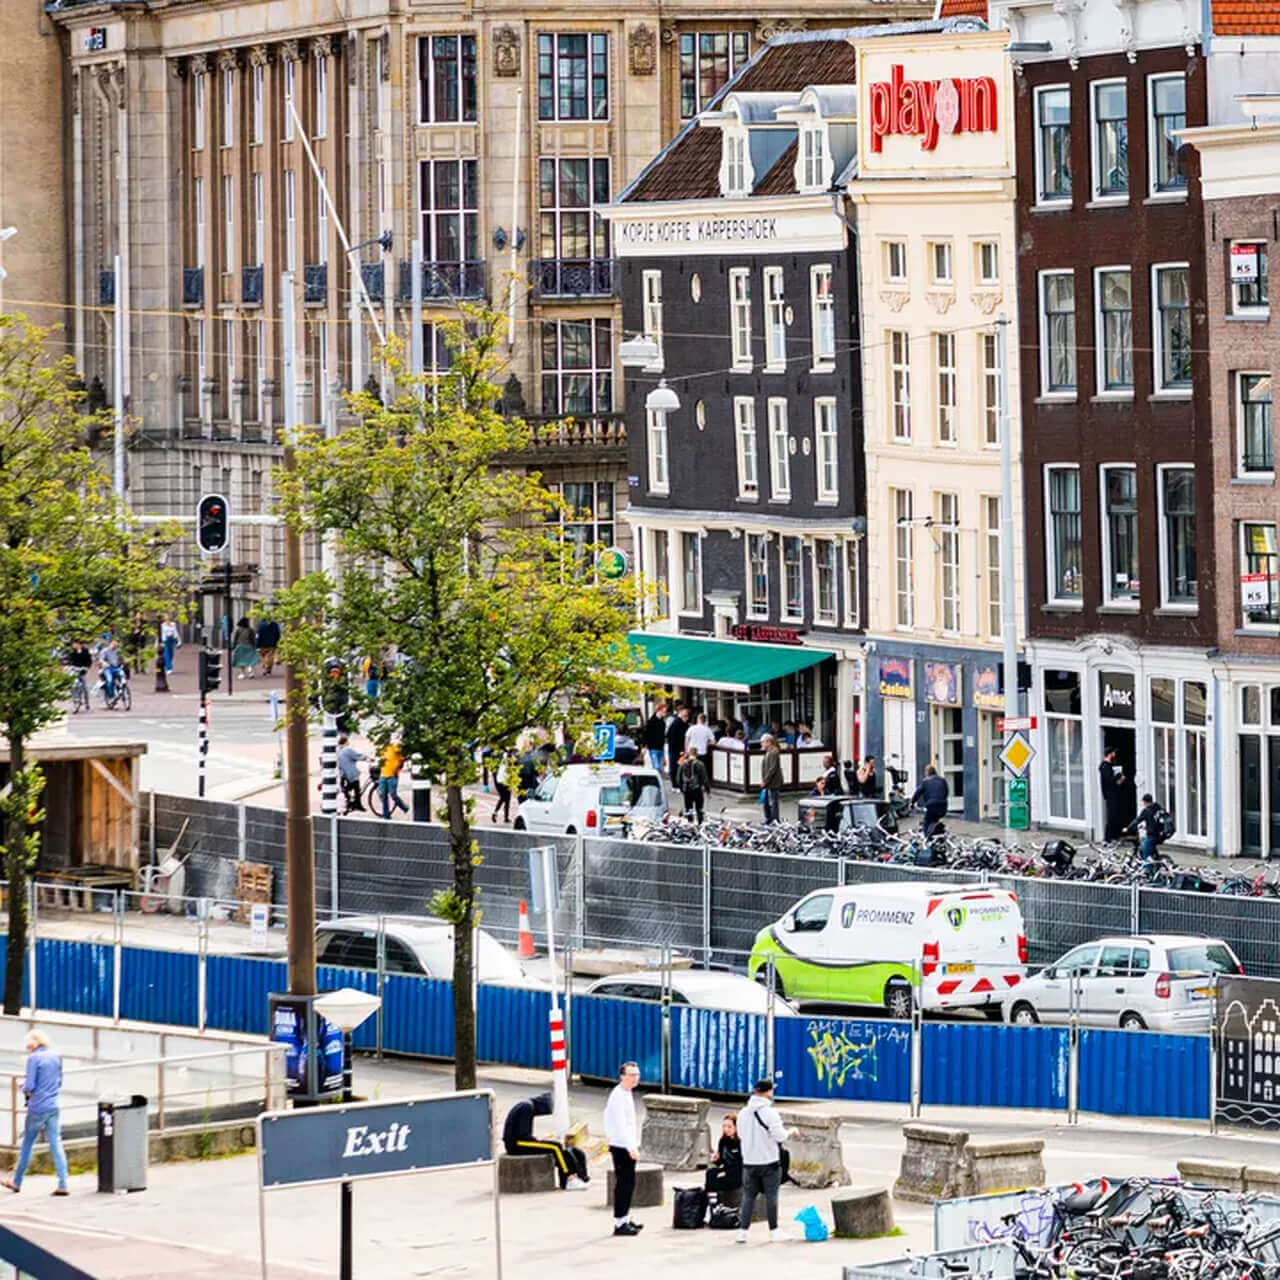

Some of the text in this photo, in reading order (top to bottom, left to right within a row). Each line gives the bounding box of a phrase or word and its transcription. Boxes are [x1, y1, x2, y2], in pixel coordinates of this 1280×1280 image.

[623, 219, 777, 242] KOPJE KOFFIE KARPERSHOEK
[879, 680, 911, 696] Casino
[1103, 684, 1133, 707] Amac
[857, 910, 915, 925] PROMMENZ
[342, 1122, 411, 1157] Exit
